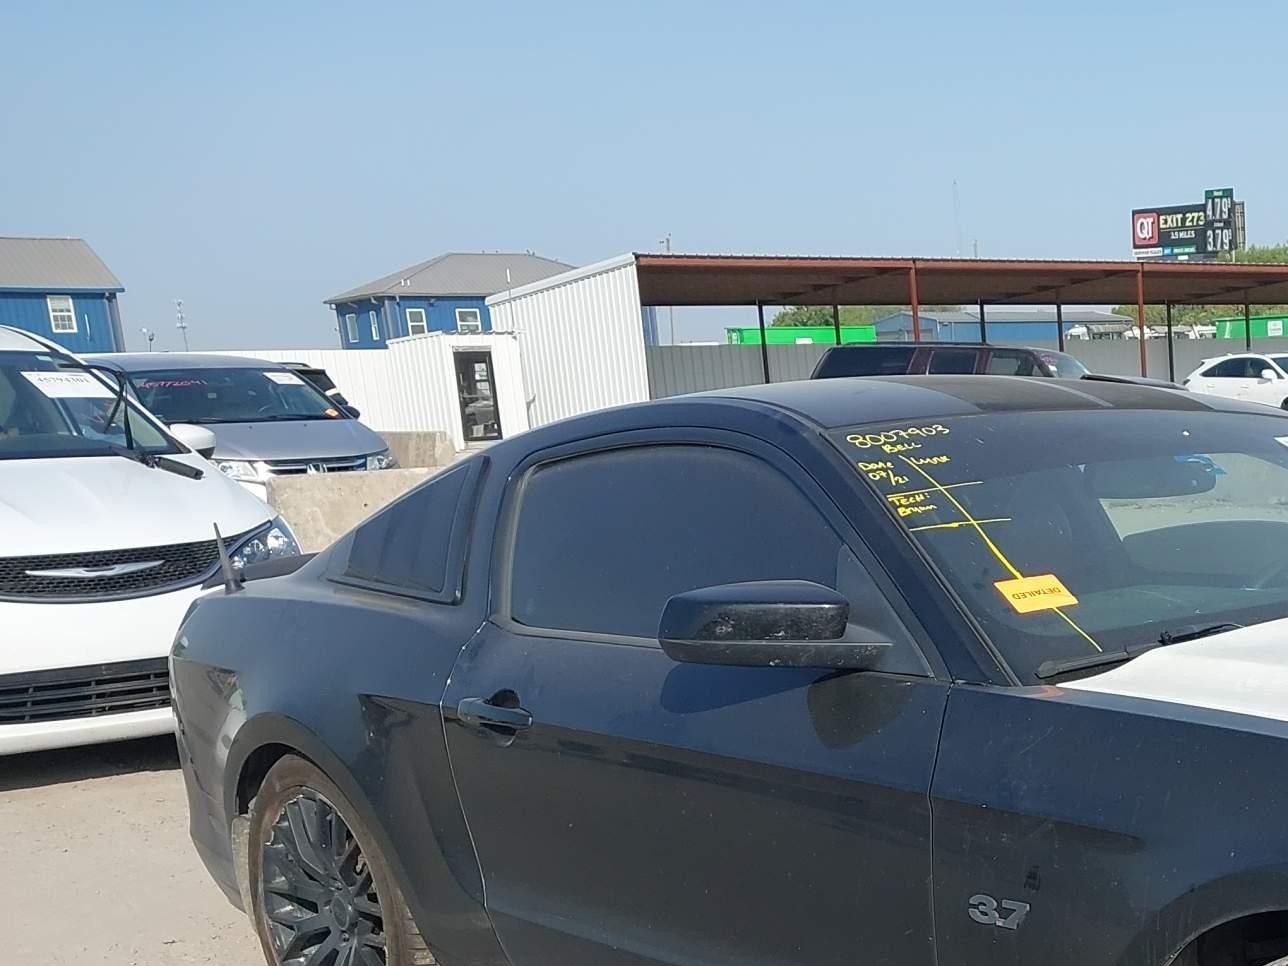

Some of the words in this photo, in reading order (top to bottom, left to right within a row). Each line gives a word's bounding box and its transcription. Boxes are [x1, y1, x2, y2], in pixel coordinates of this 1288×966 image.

[1159, 214, 1183, 228] EXIT
[1185, 212, 1205, 226] 273
[1137, 218, 1154, 240] QT
[1180, 230, 1195, 238] MILES
[846, 424, 950, 448] 8007903
[868, 470, 909, 486] 07/21
[1011, 586, 1062, 600] DETAILED
